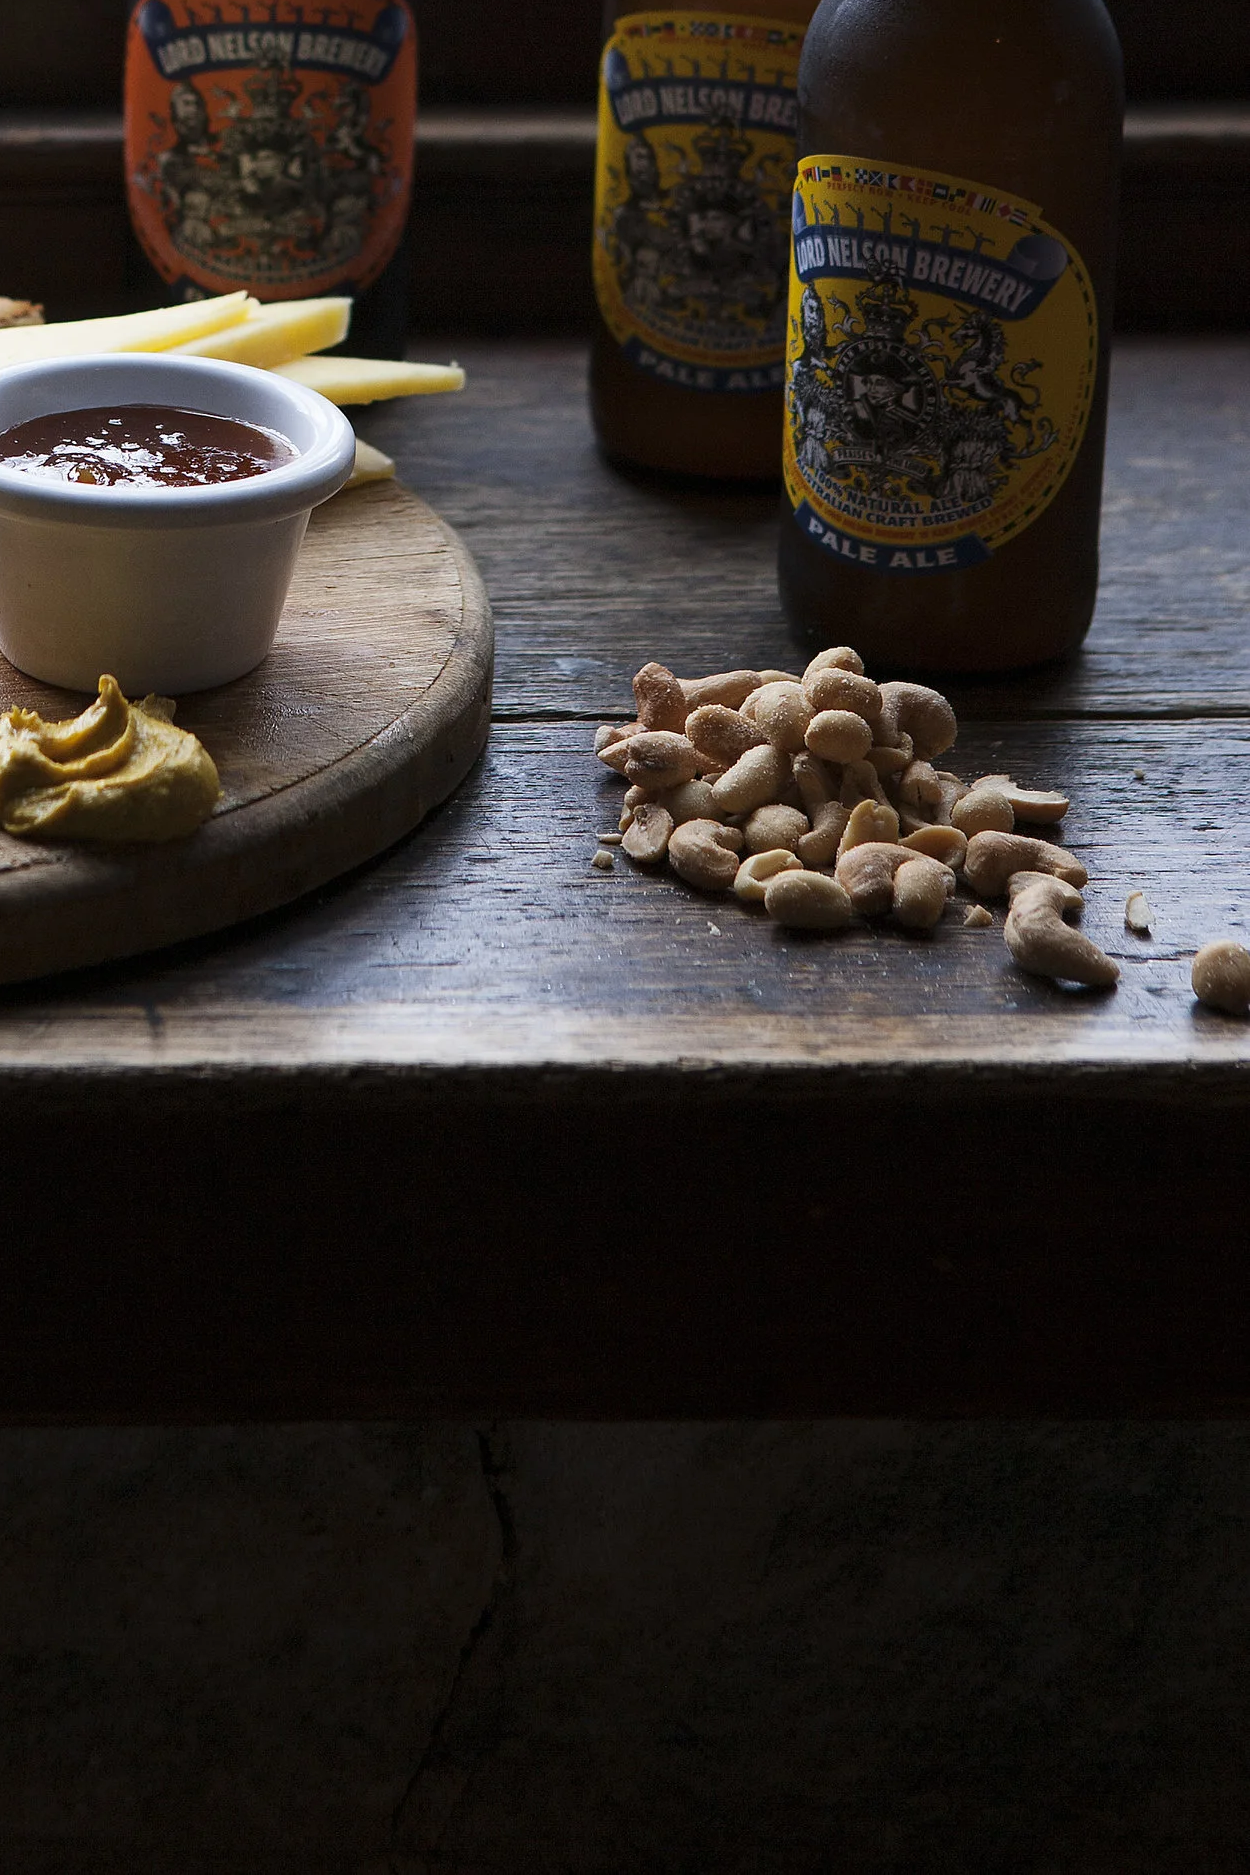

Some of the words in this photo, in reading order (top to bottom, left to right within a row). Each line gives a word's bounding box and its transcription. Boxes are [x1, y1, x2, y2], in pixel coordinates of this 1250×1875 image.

[659, 85, 745, 123] NELSON
[796, 235, 826, 275] LORD
[826, 233, 909, 275] NELSON
[913, 249, 1035, 315] BREWERY
[639, 350, 716, 389] PALE
[814, 467, 843, 497] 100%
[847, 490, 924, 515] NATURAL
[930, 496, 962, 514] ALE
[866, 512, 916, 528] CRAFT
[921, 498, 993, 527] BREWED
[808, 517, 878, 565] PALE
[888, 546, 959, 569] ALE
